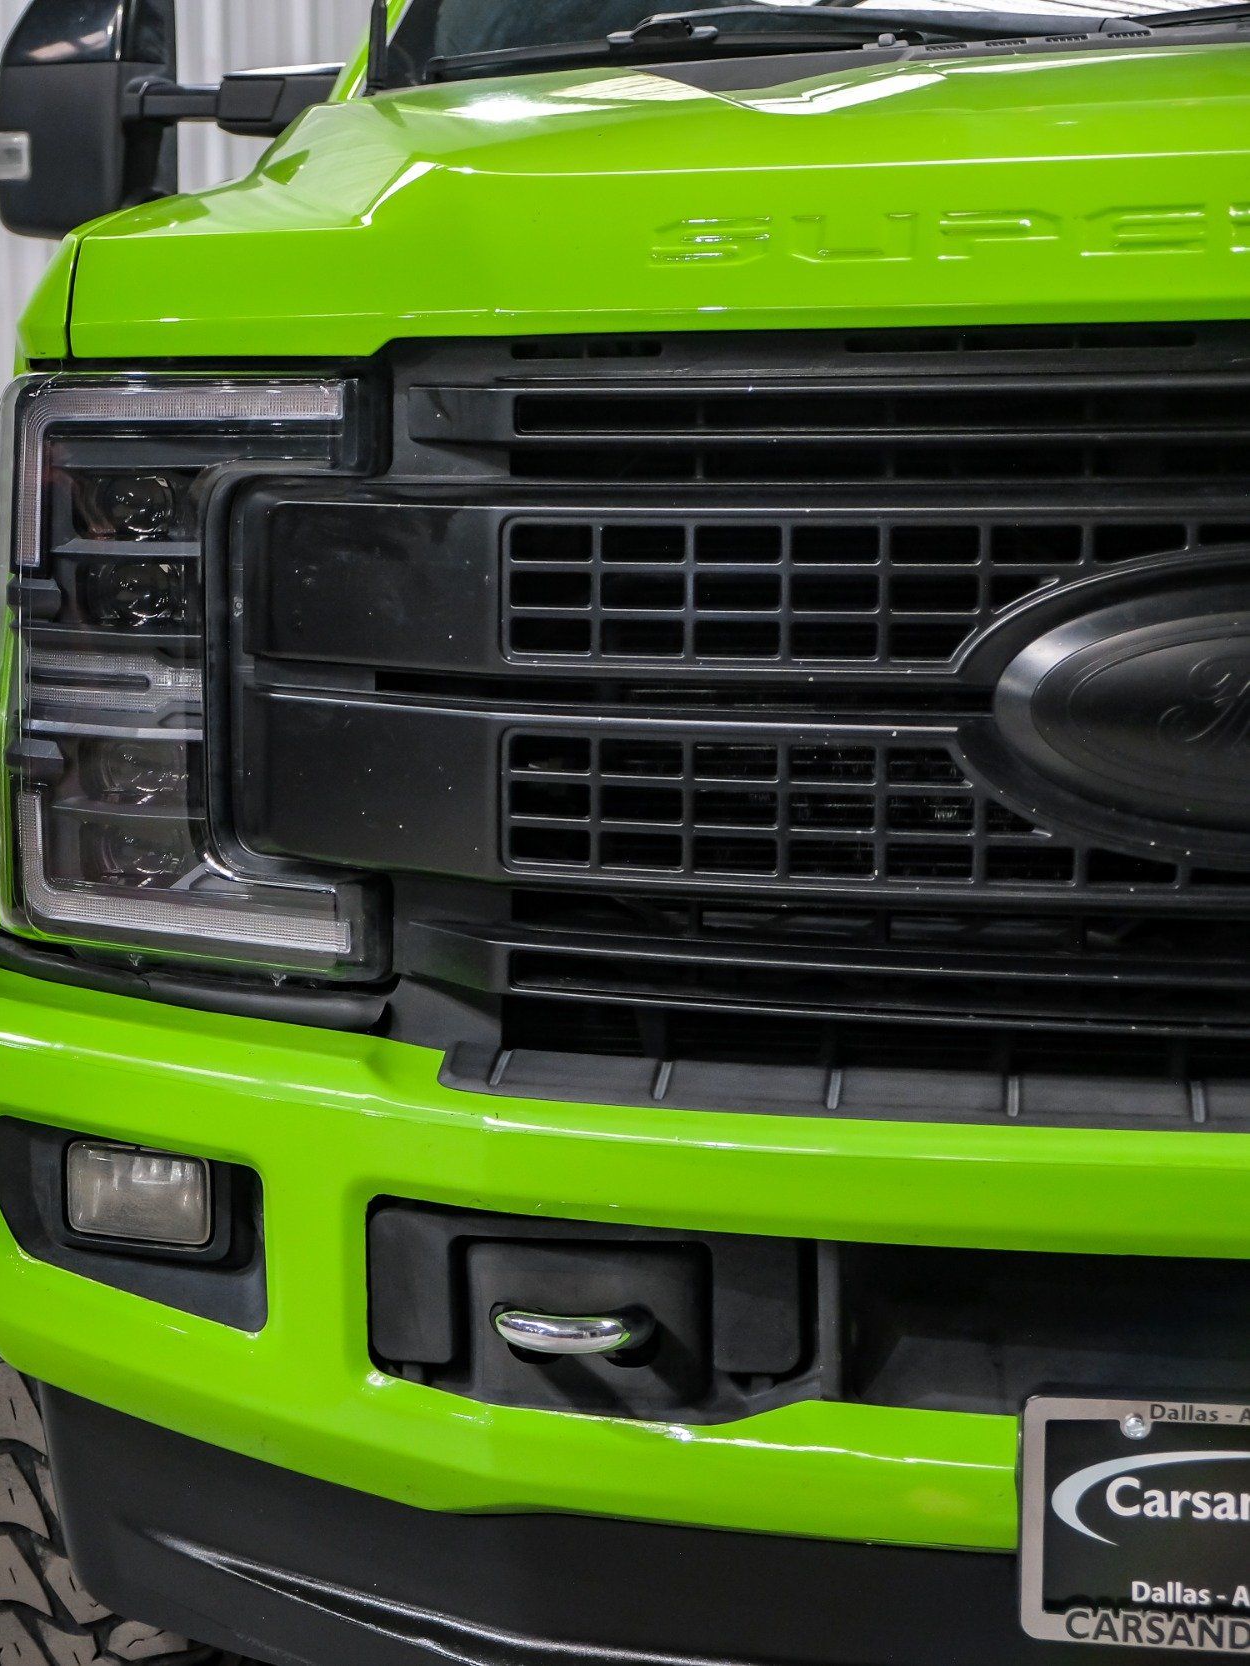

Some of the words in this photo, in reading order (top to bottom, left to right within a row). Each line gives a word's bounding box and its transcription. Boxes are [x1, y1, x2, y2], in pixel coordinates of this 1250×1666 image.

[649, 202, 1250, 267] SUPE
[1150, 1403, 1219, 1422] Dallas
[1131, 1581, 1211, 1606] Dallas
[1064, 1610, 1250, 1650] CARSAND
